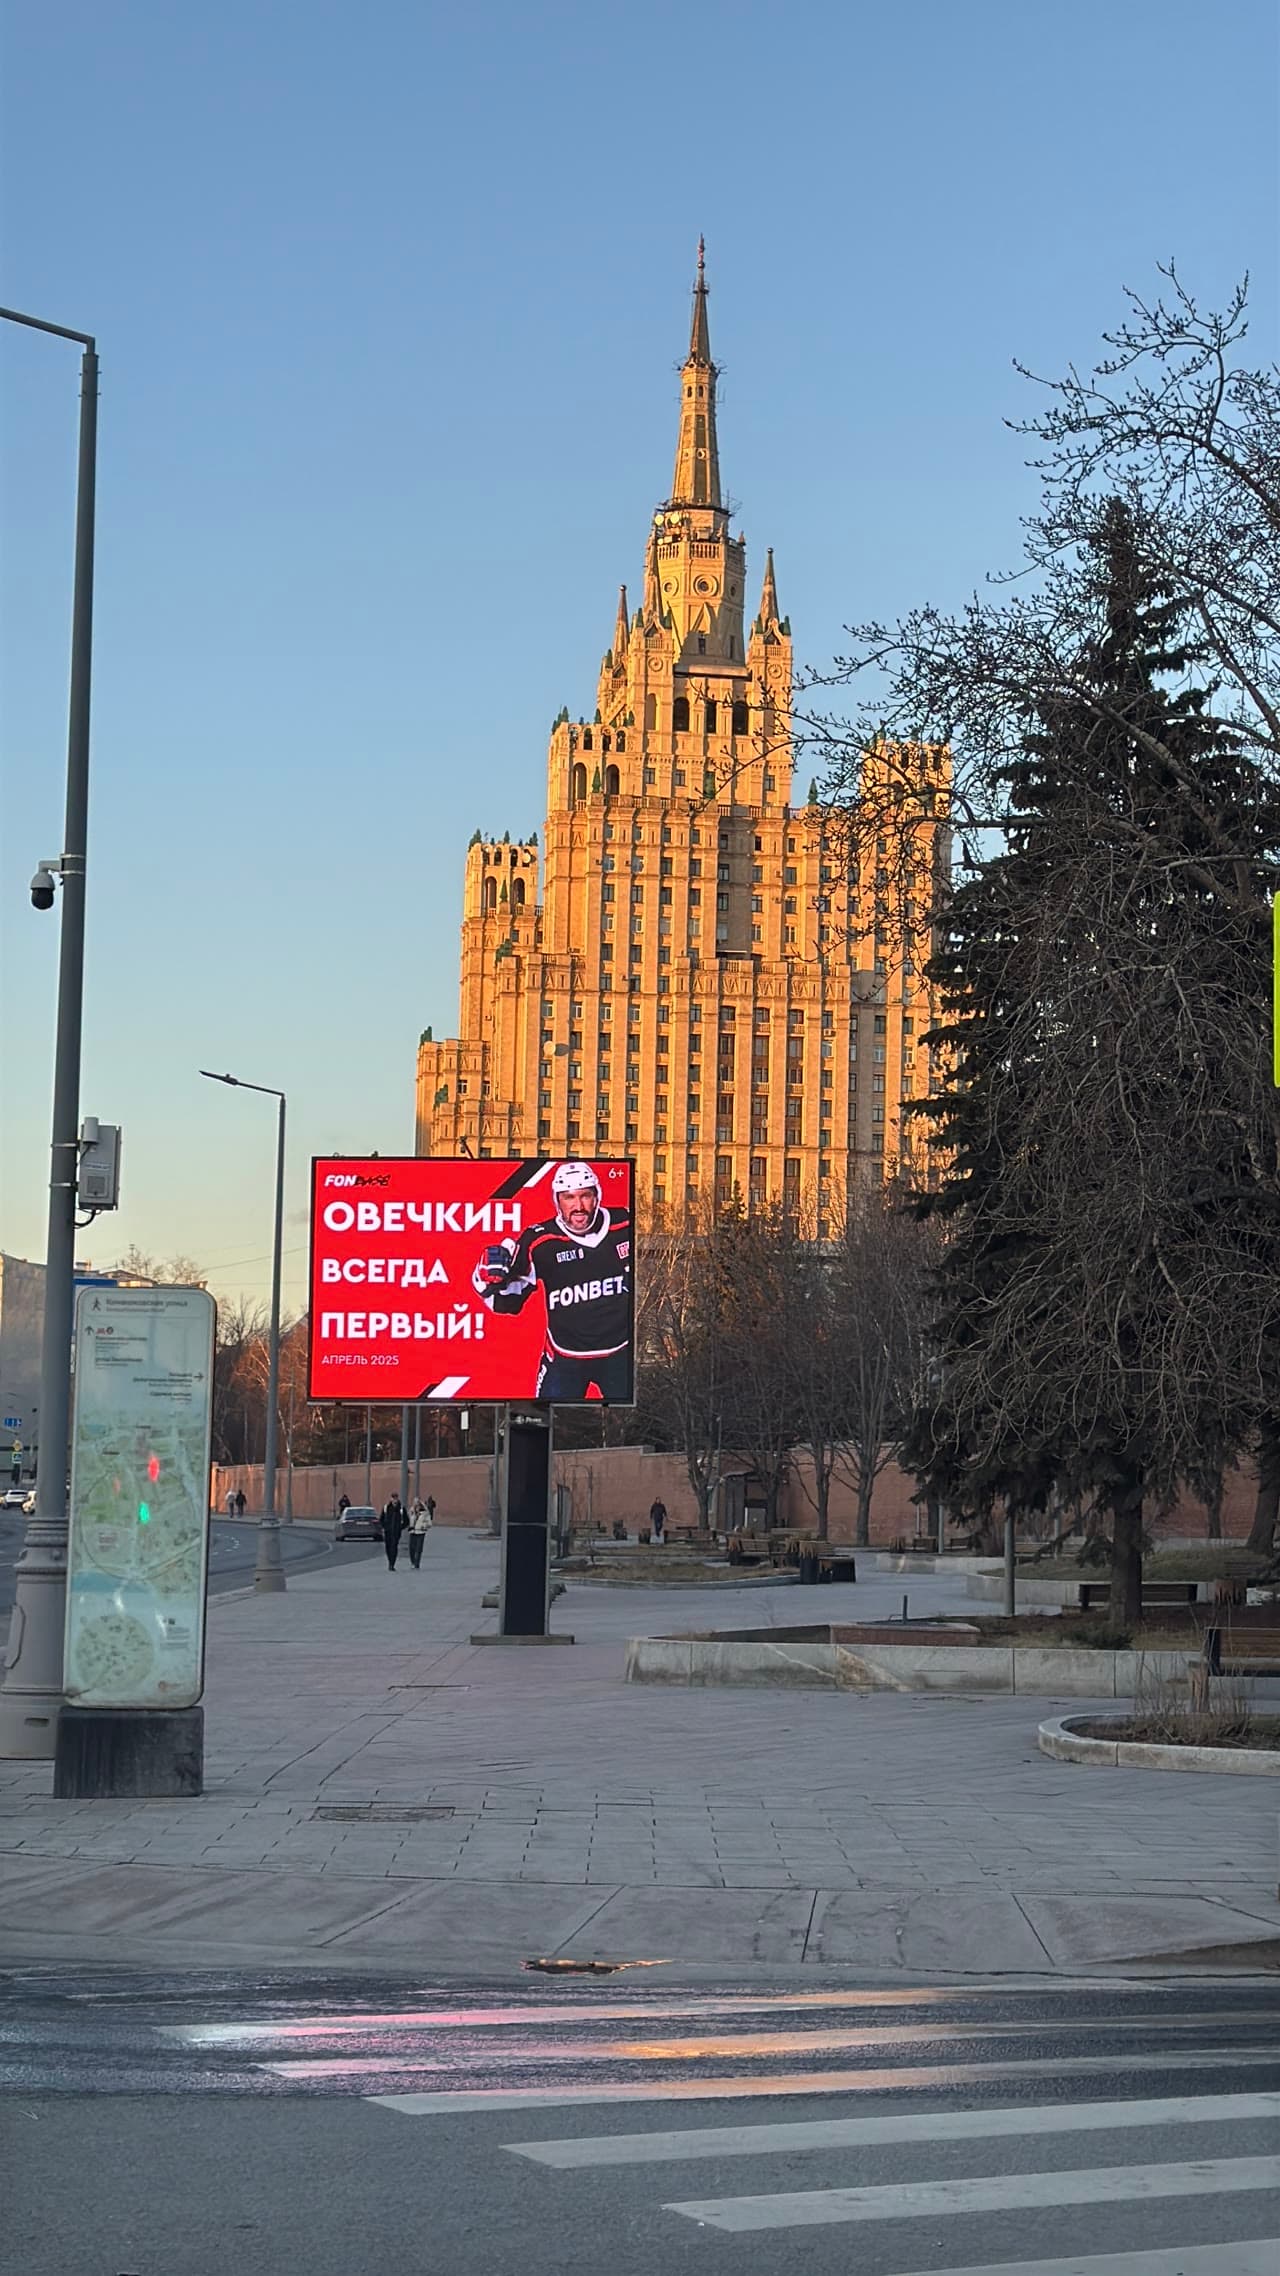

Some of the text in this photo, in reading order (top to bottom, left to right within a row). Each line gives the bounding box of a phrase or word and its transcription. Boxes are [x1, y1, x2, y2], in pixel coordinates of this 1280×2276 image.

[608, 1167, 625, 1179] 6+
[323, 1202, 522, 1233] ОВЕЧКИН
[321, 1259, 449, 1288] ВСЕГДА
[549, 1276, 624, 1310] FONBET
[321, 1304, 485, 1339] ПЕРВЫЙ!
[321, 1355, 400, 1366] АПРЕЛЬ 2025
